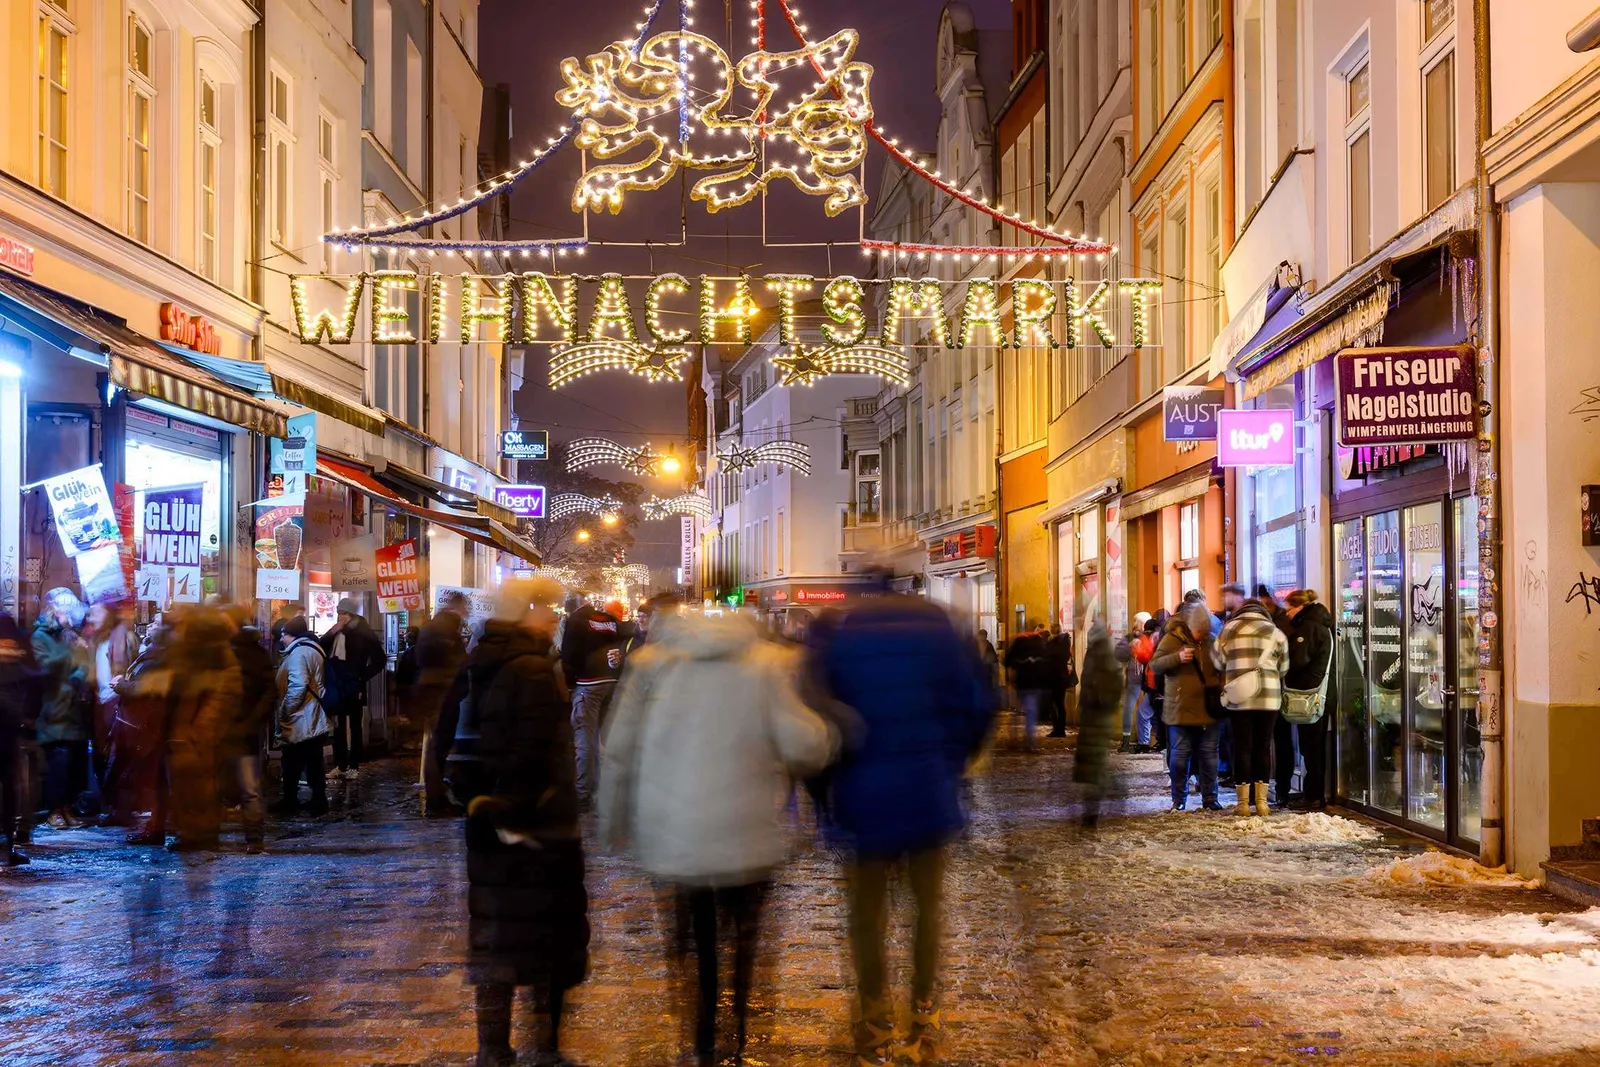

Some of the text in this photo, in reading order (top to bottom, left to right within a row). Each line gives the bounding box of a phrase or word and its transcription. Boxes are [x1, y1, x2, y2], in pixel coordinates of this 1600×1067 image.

[290, 271, 1164, 349] WEIHNACHTSMARKT
[160, 302, 222, 356] Shin Shin
[1353, 356, 1461, 388] Friseur
[1169, 403, 1222, 423] AUST
[1346, 388, 1472, 422] Nagelstudio
[1347, 420, 1474, 438] WIMPERNVERLÄNGERUNG
[284, 451, 302, 460] Coffee
[504, 444, 545, 452] MASSAGEN
[52, 480, 87, 502] Glüh
[498, 491, 540, 510] liberty
[145, 497, 201, 532] GLÜH
[256, 506, 303, 528] GRILL
[1340, 534, 1363, 561] NAGEL
[1369, 527, 1400, 557] STUDIO
[1408, 522, 1441, 552] FRISEUR
[144, 533, 199, 564] WEIN
[376, 557, 416, 578] GLÜH
[265, 584, 283, 593] 3.50
[342, 577, 368, 586] Kaffee
[378, 578, 419, 597] WEIN
